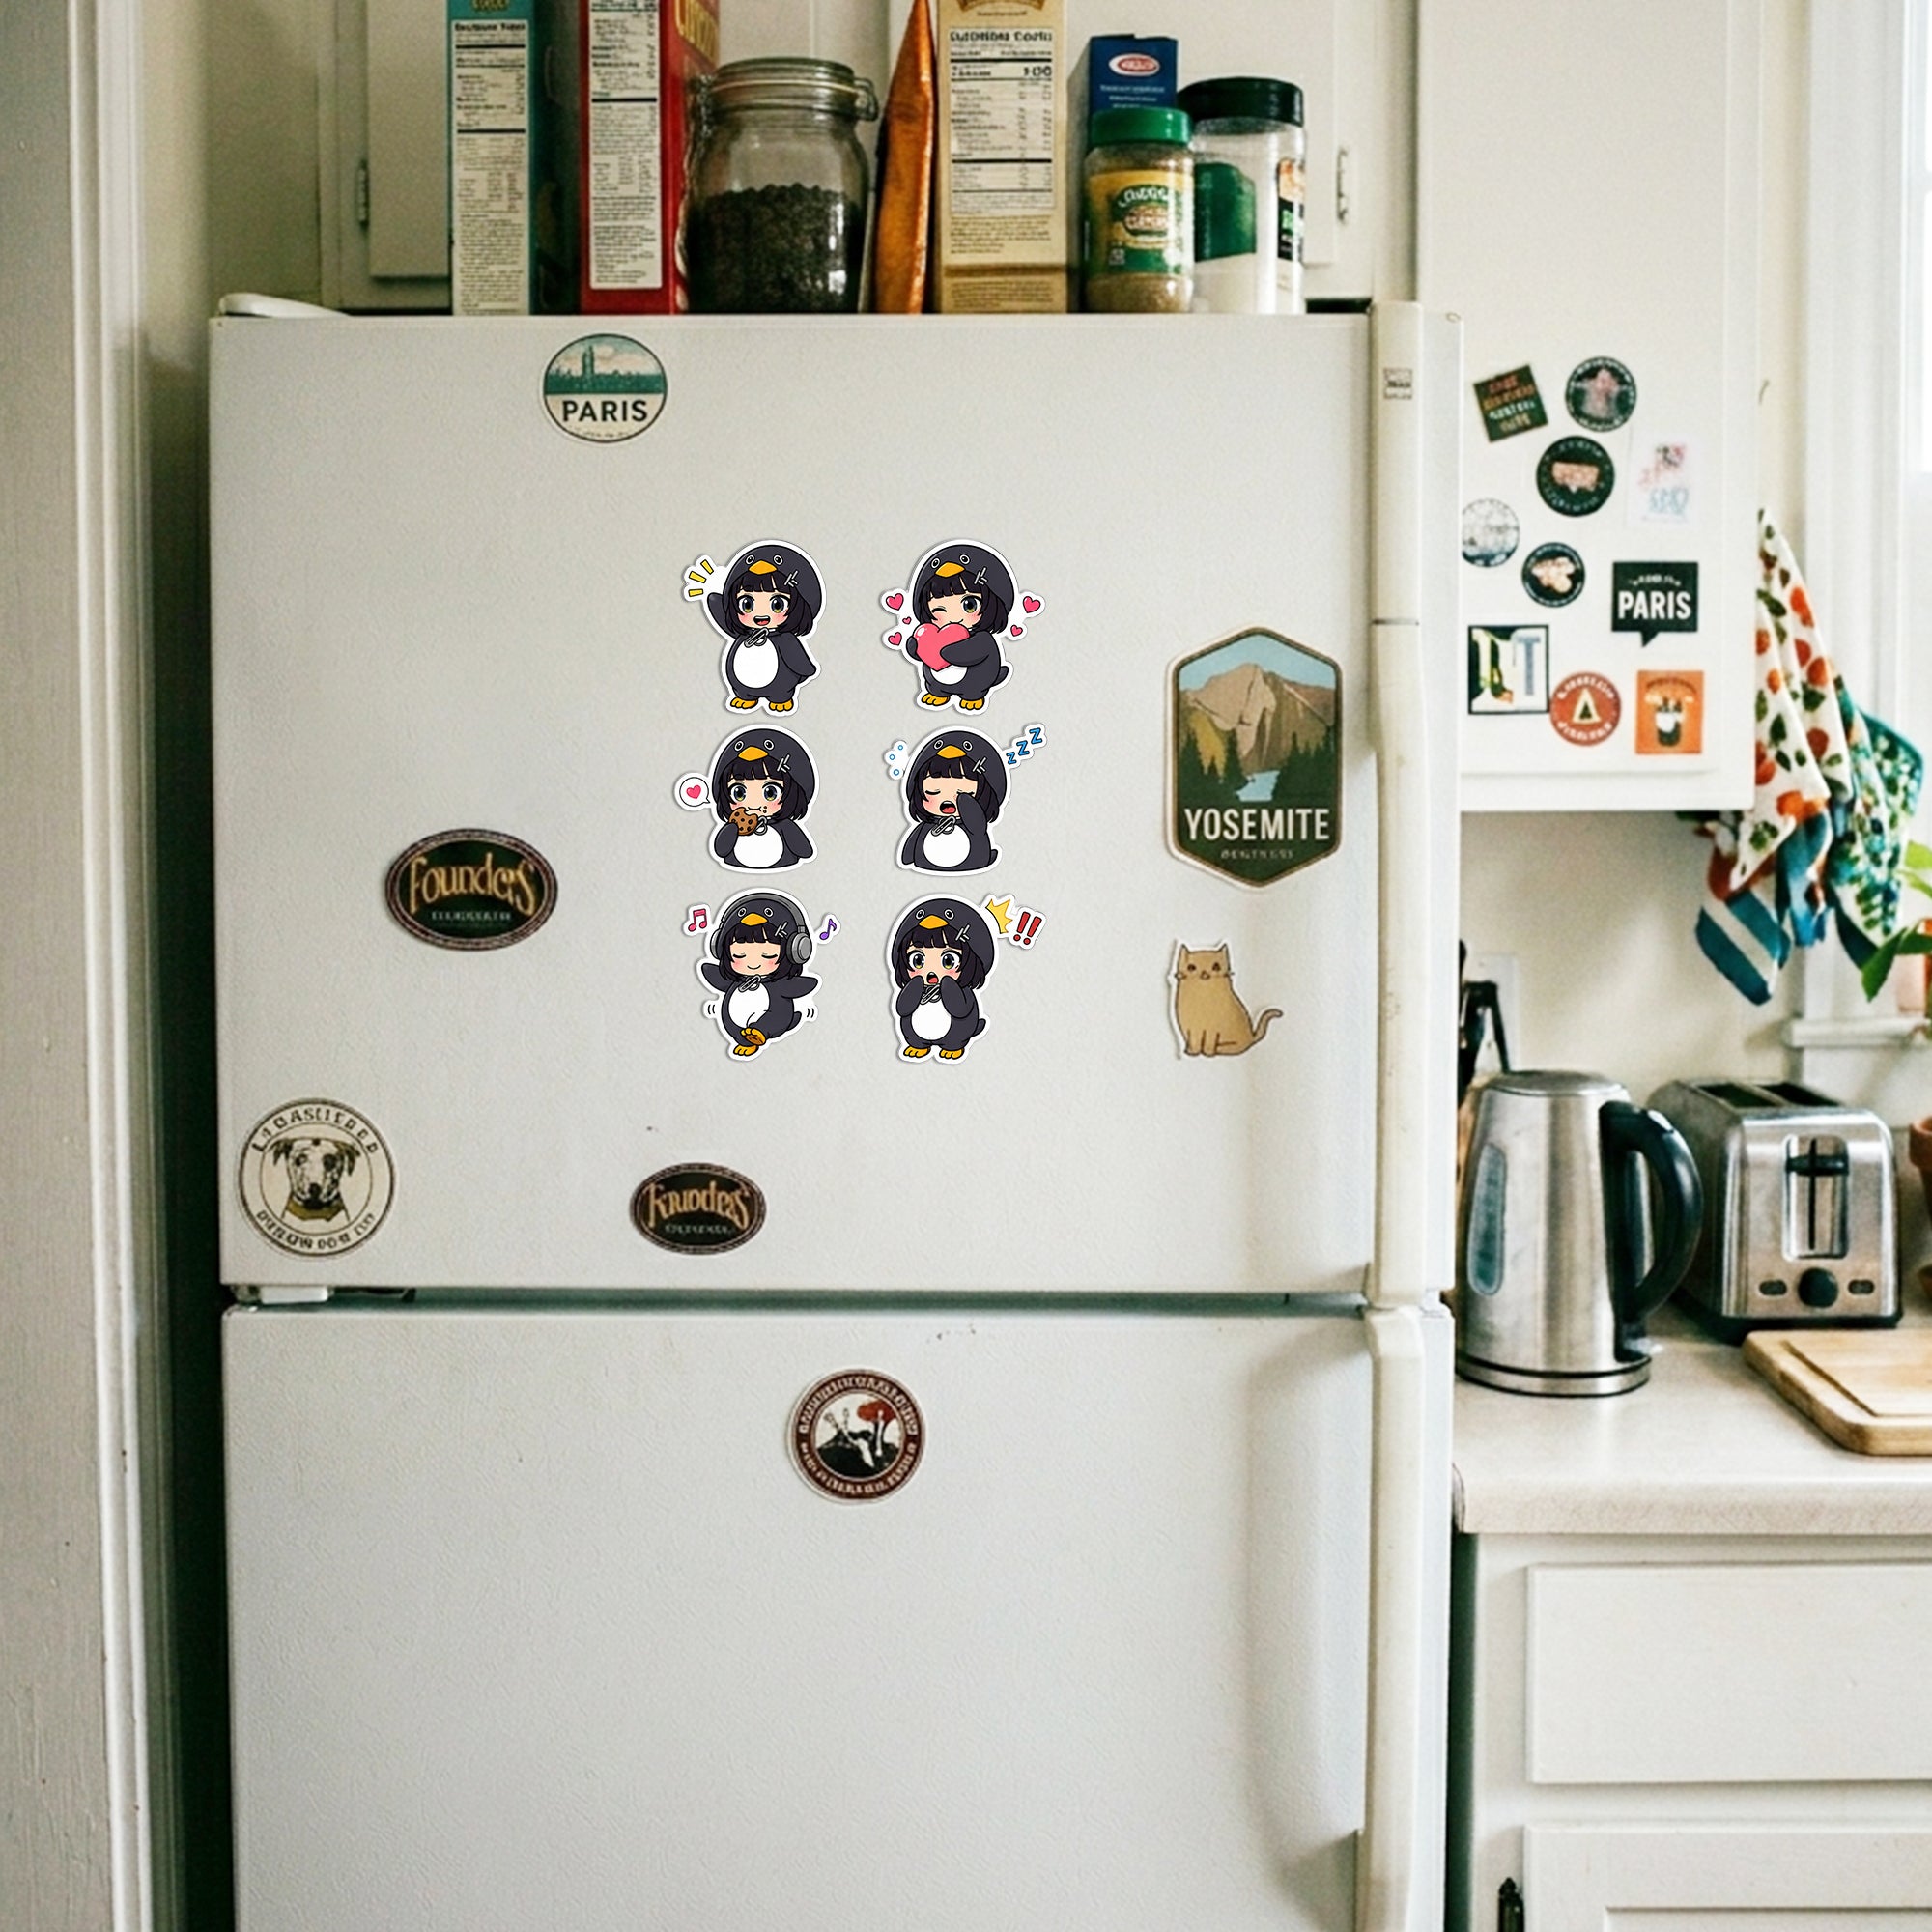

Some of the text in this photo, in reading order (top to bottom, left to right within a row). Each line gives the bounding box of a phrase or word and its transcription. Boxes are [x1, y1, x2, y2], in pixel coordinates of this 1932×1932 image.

[562, 400, 648, 422] PARIS
[1618, 590, 1691, 619] PARIS
[1184, 808, 1330, 840] YOSEMITE
